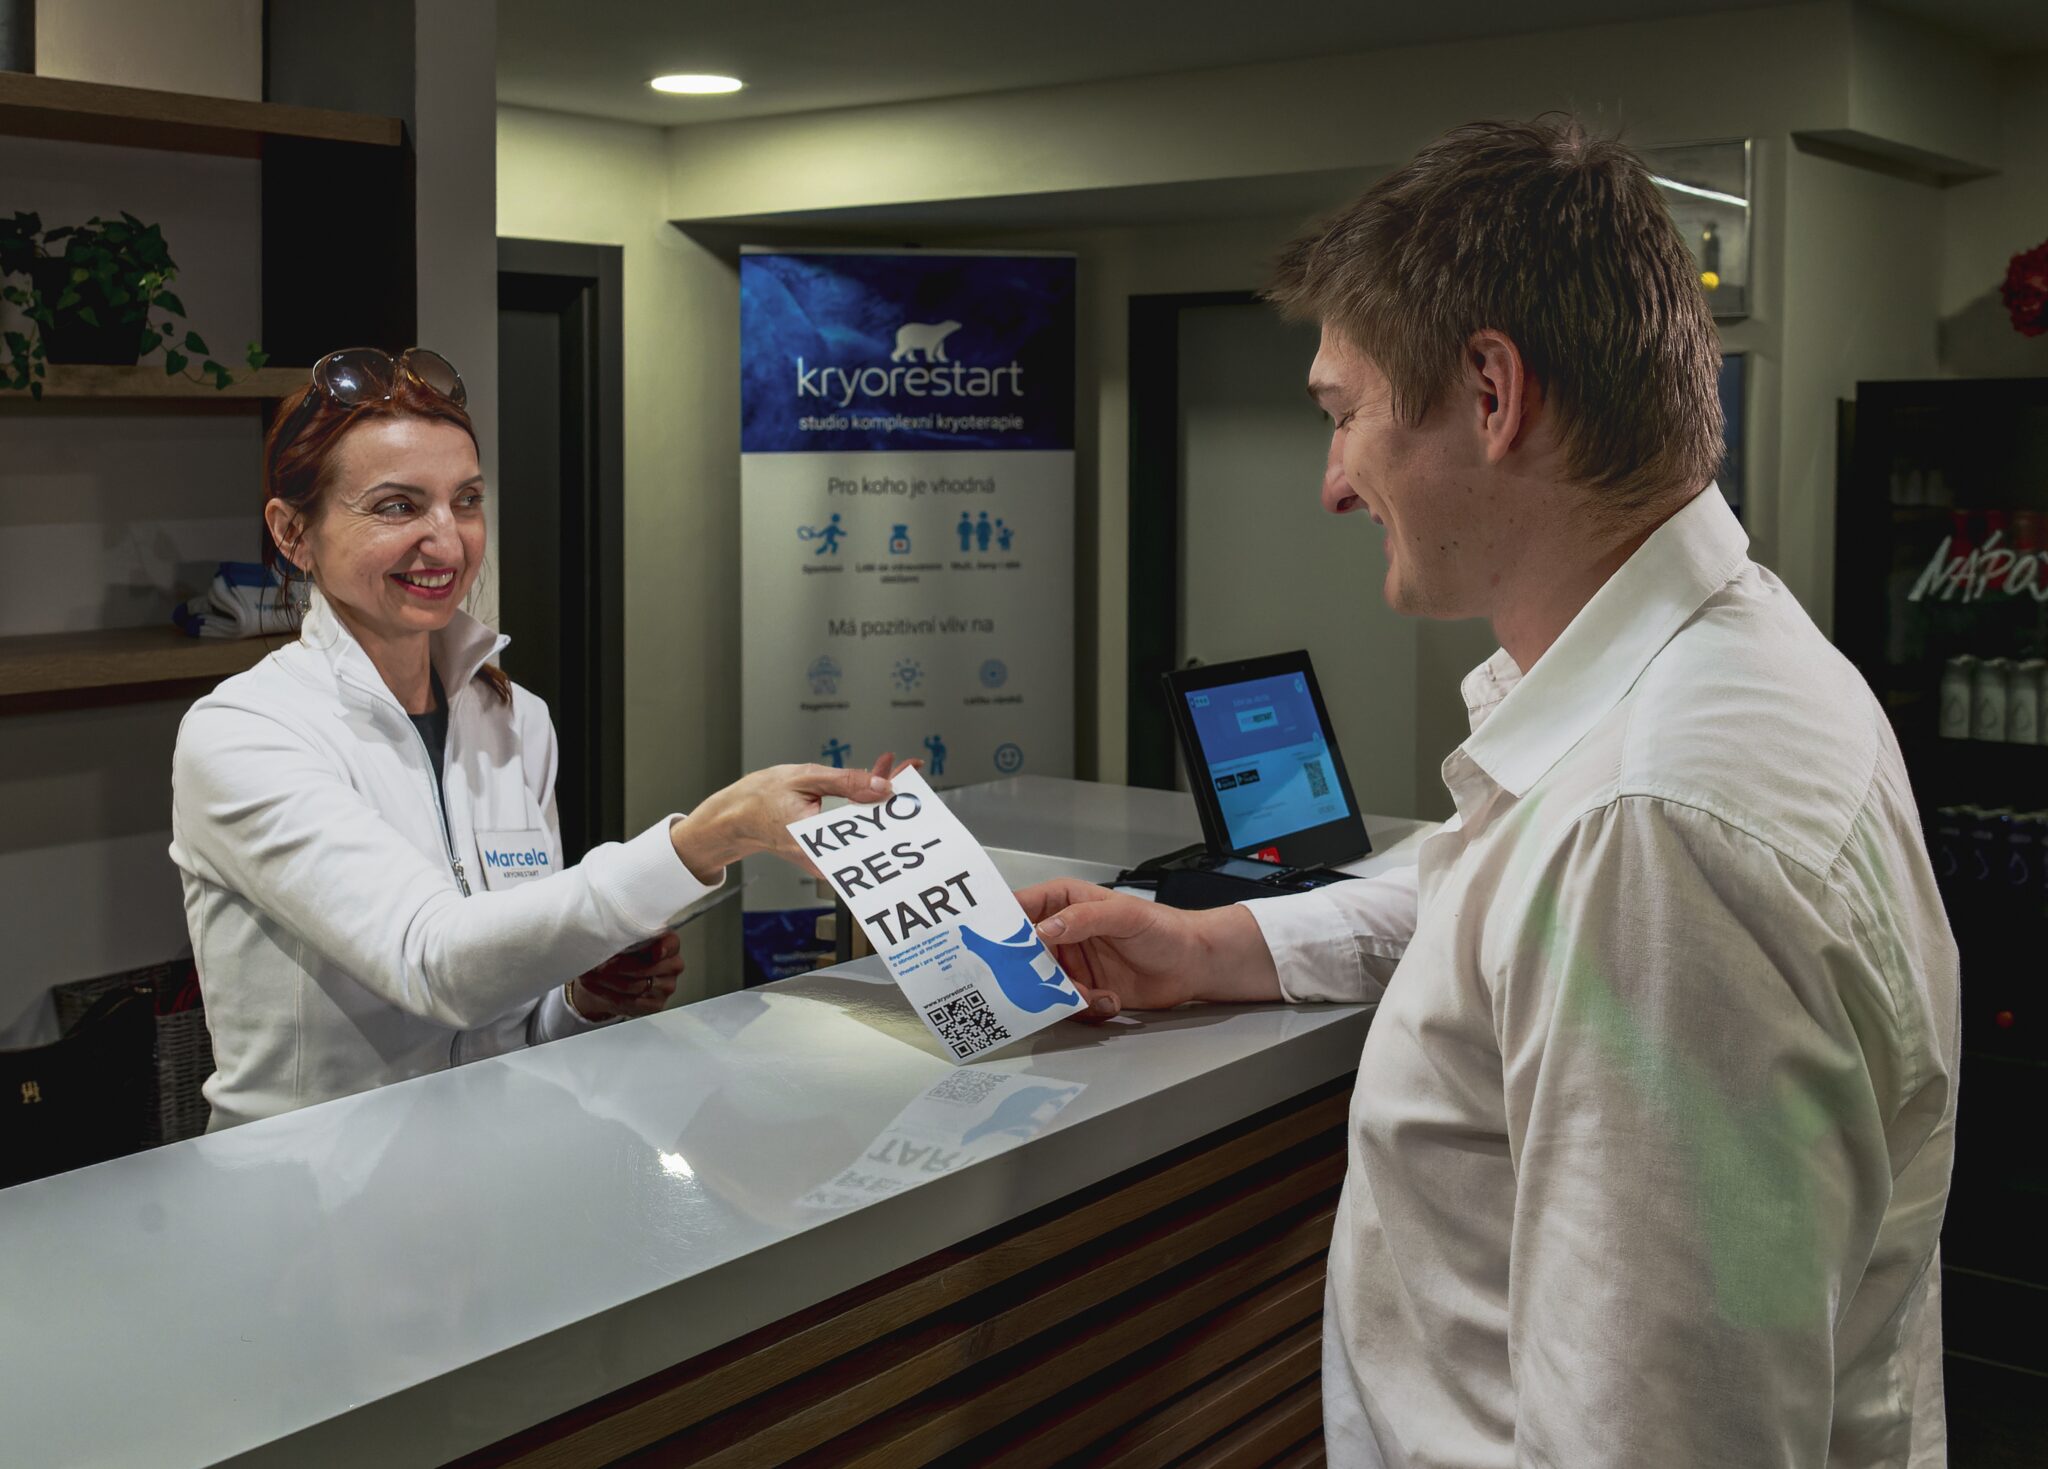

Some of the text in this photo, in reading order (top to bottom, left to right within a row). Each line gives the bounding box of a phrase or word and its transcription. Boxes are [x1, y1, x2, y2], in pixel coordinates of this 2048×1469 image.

[797, 357, 1024, 408] kryorestart
[798, 414, 849, 431] studio
[936, 413, 1024, 433] kryoterapie
[827, 475, 996, 498] Pro koho je vhodná
[828, 616, 994, 638] Má pozitivní vliv na
[800, 792, 922, 858] KRYO
[485, 848, 548, 867] Marcela
[832, 838, 942, 898] RES-
[865, 870, 978, 946] TART
